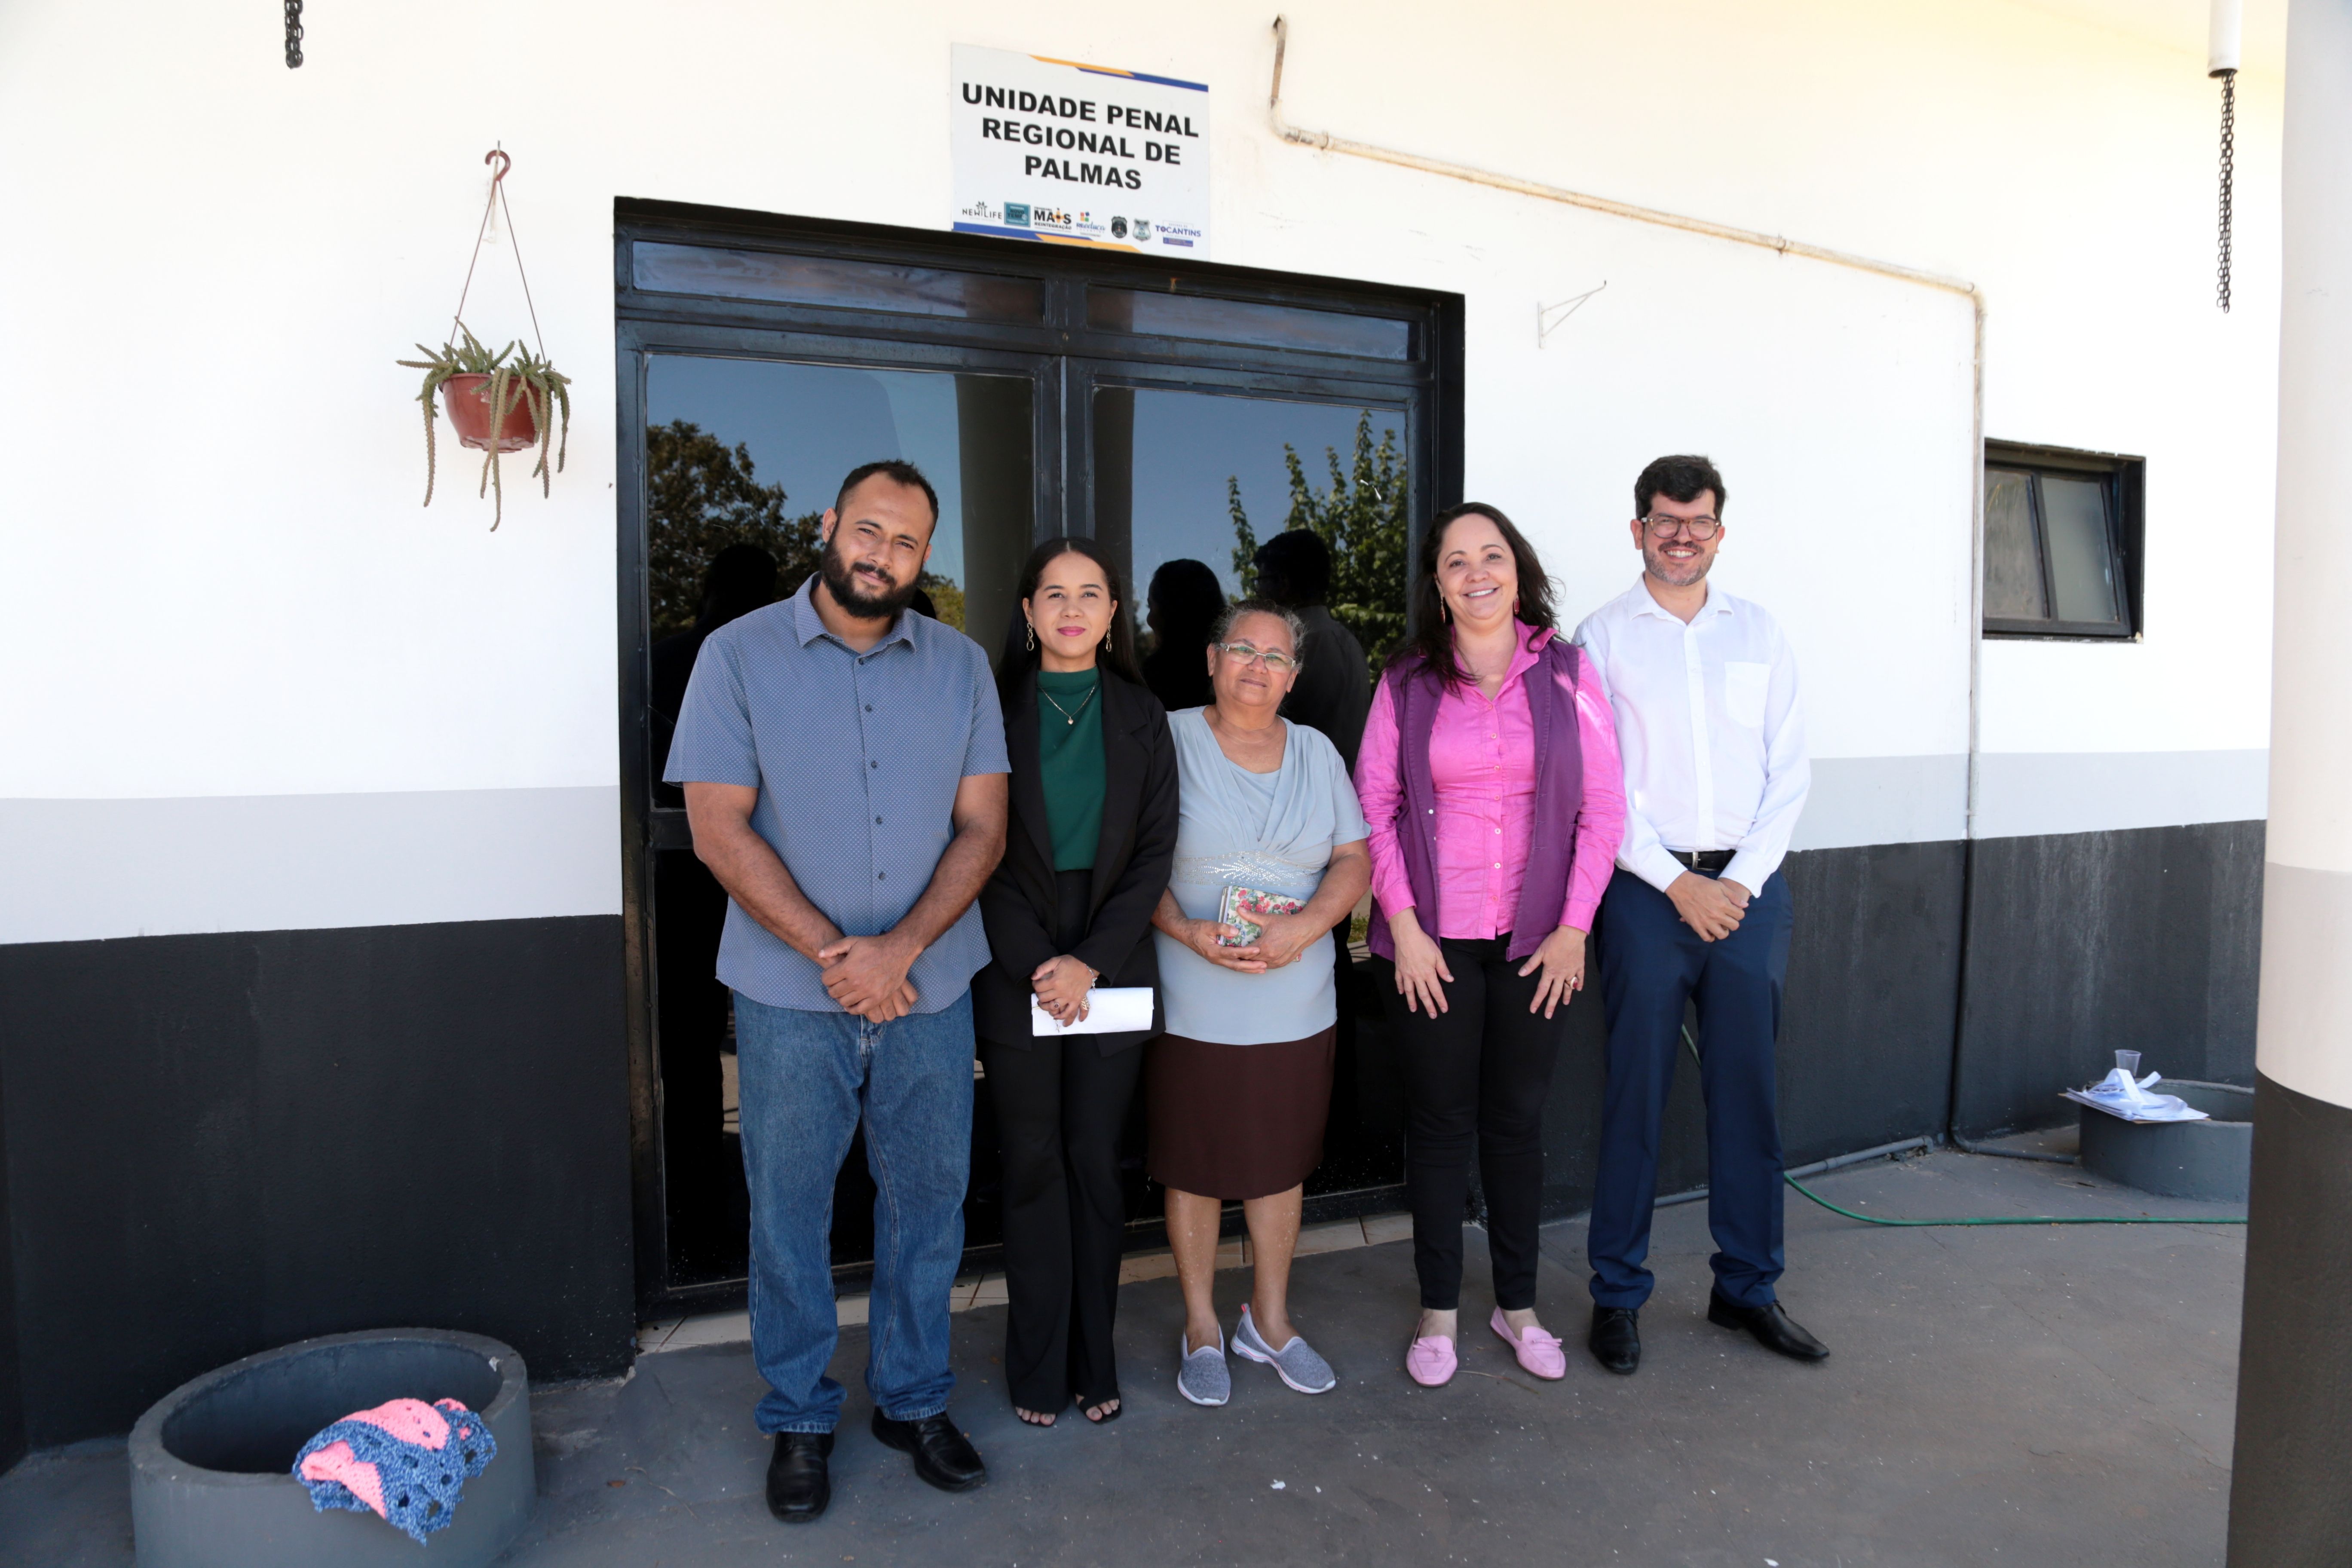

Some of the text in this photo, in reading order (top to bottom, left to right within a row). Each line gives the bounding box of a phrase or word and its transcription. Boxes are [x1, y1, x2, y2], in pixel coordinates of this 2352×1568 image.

[962, 82, 1199, 138] UNIDADE PENAL
[983, 117, 1181, 165] REGIONAL DE
[1025, 155, 1142, 190] PALMAS
[1034, 221, 1072, 230] REINTEGRAÇÃO
[1155, 225, 1201, 237] TOCANTINS
